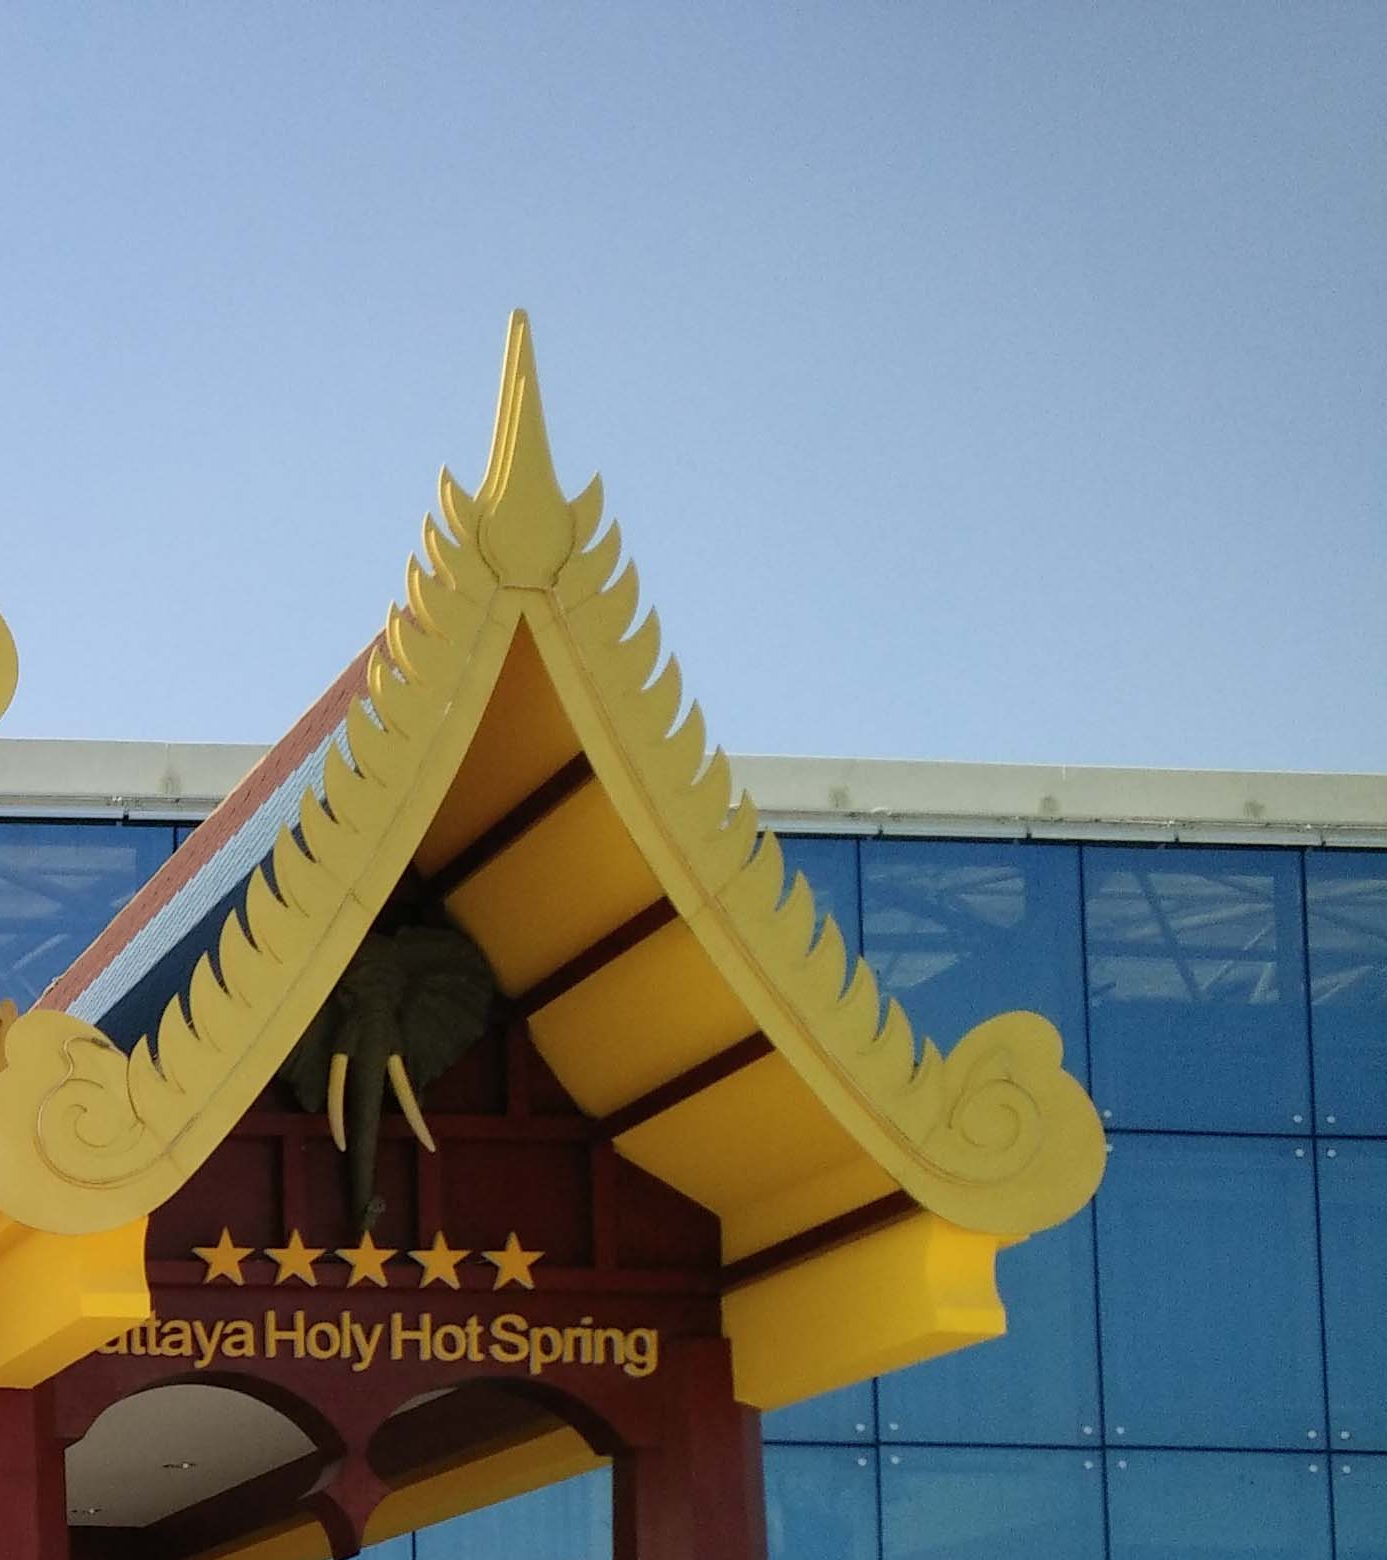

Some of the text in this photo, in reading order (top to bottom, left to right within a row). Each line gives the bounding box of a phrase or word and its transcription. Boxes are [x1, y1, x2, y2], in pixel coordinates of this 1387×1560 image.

[266, 1310, 382, 1371] Holy
[391, 1313, 484, 1362] Hot
[489, 1314, 659, 1376] Spring
